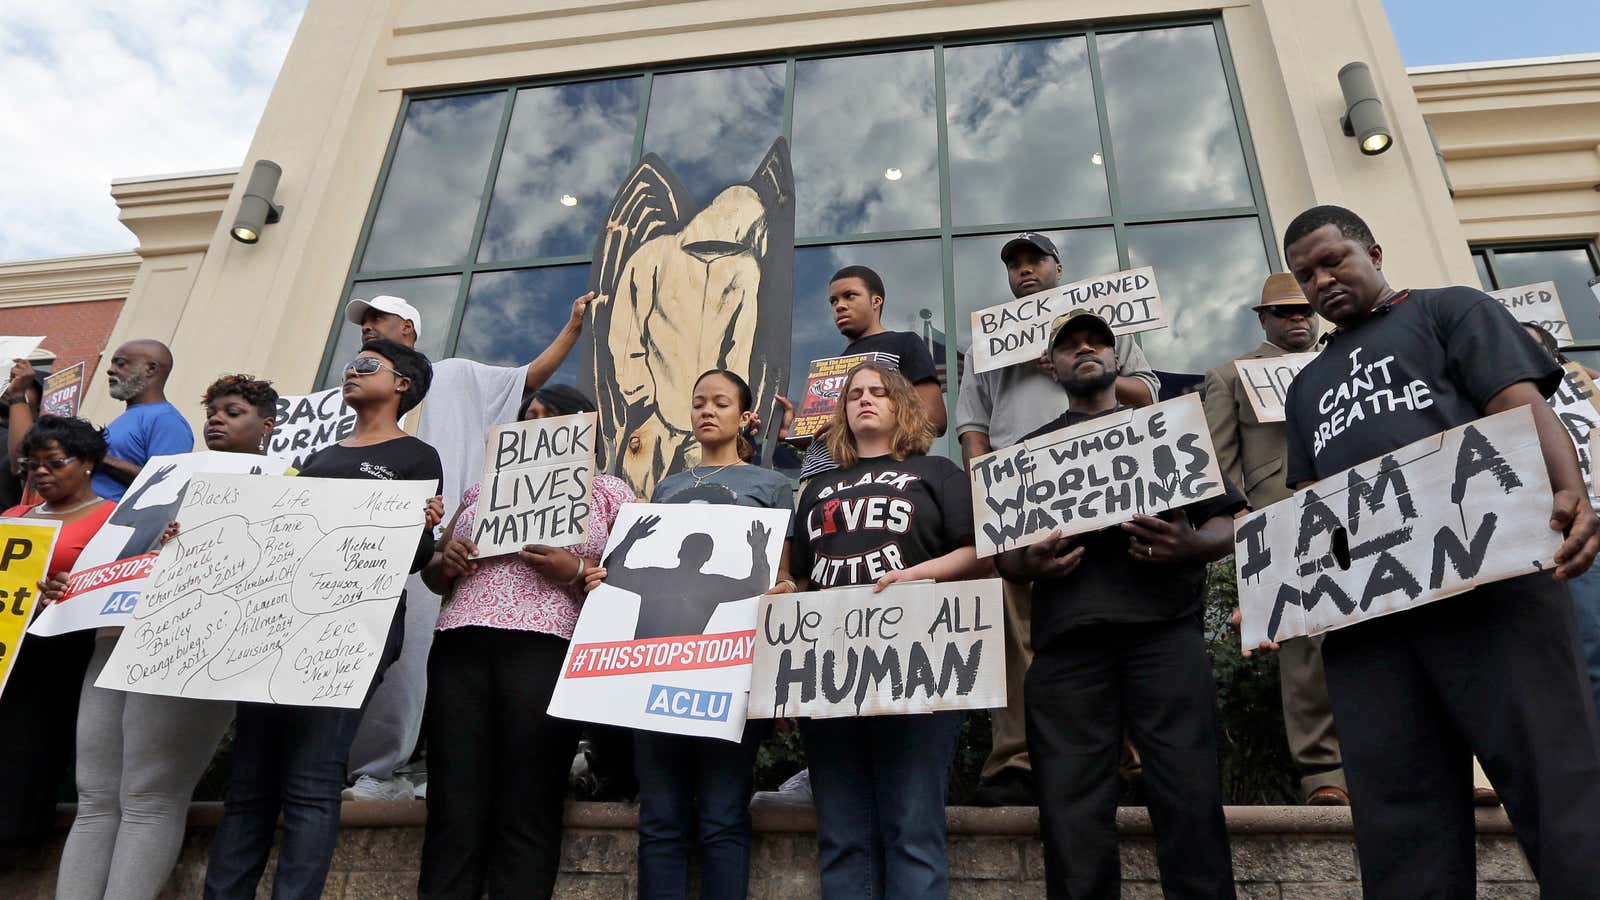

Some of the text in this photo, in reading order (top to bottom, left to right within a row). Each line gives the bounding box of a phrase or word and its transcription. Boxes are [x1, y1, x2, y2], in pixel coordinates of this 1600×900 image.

[980, 274, 1150, 334] BACK TURNED
[989, 296, 1156, 356] DON'T OOT
[1348, 347, 1362, 376] I
[51, 385, 78, 405] STOP
[1318, 355, 1395, 415] CAN'T
[1313, 379, 1434, 458] BREATHE
[496, 421, 594, 468] BLACK
[972, 411, 1167, 490] THE WHOLE
[490, 466, 588, 512] LIVES
[817, 471, 919, 500] BLACK
[986, 433, 1210, 515] WORLD IS
[271, 488, 311, 509] Life
[983, 473, 1219, 546] WATCHING
[1236, 425, 1522, 582] I AM A
[476, 501, 590, 545] MATTER
[264, 538, 292, 556] Rice
[268, 549, 295, 567] 2014
[345, 553, 388, 571] Brown
[212, 558, 245, 589] 2014
[1267, 511, 1497, 642] MAN
[331, 590, 362, 607] 2014
[267, 615, 294, 637] 2014
[764, 596, 992, 646] We are ALL
[177, 649, 210, 676] 2011
[571, 637, 755, 673] #THISSTOPSTODAY
[312, 680, 354, 701] 2014
[775, 639, 983, 713] HUMAN
[649, 687, 728, 718] ACLU
